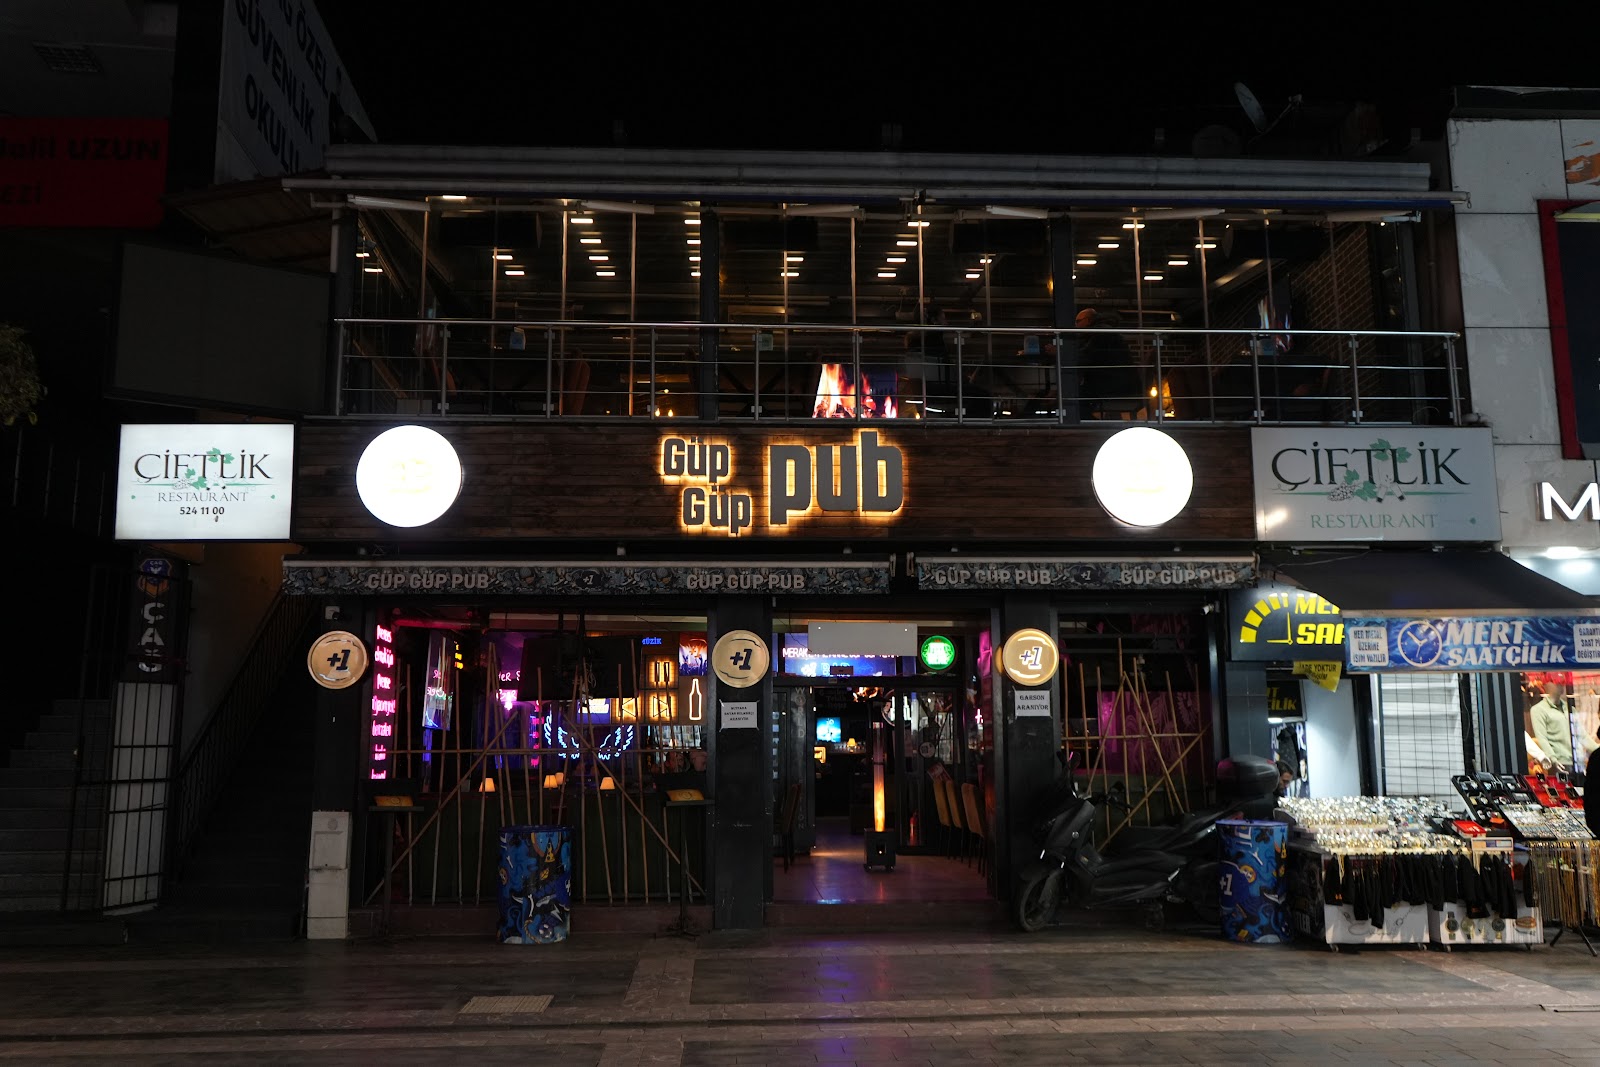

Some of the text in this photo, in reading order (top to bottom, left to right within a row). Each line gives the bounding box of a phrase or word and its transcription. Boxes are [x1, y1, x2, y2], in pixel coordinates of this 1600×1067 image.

[297, 3, 328, 98] ÖZEL
[70, 136, 160, 161] UZUN
[134, 448, 273, 484] ÇİFTLİK
[1271, 440, 1471, 492] ÇİFTLİK
[769, 430, 904, 525] pub
[157, 491, 250, 503] RESTAURANT
[179, 506, 225, 516] 524 11 00
[1310, 512, 1439, 530] RESTAURANT
[366, 570, 490, 589] GÜP GÜP PUB
[686, 571, 806, 590] GÜP GÜP PUB
[935, 567, 1052, 585] GÜP GÜP PUB
[1120, 566, 1236, 585] GÜP GÜP PUB
[1446, 620, 1530, 646] MERT
[327, 650, 350, 671] +1
[729, 649, 753, 671] +1
[1019, 646, 1043, 670] +1
[1448, 640, 1566, 667] SAATÇİLİK
